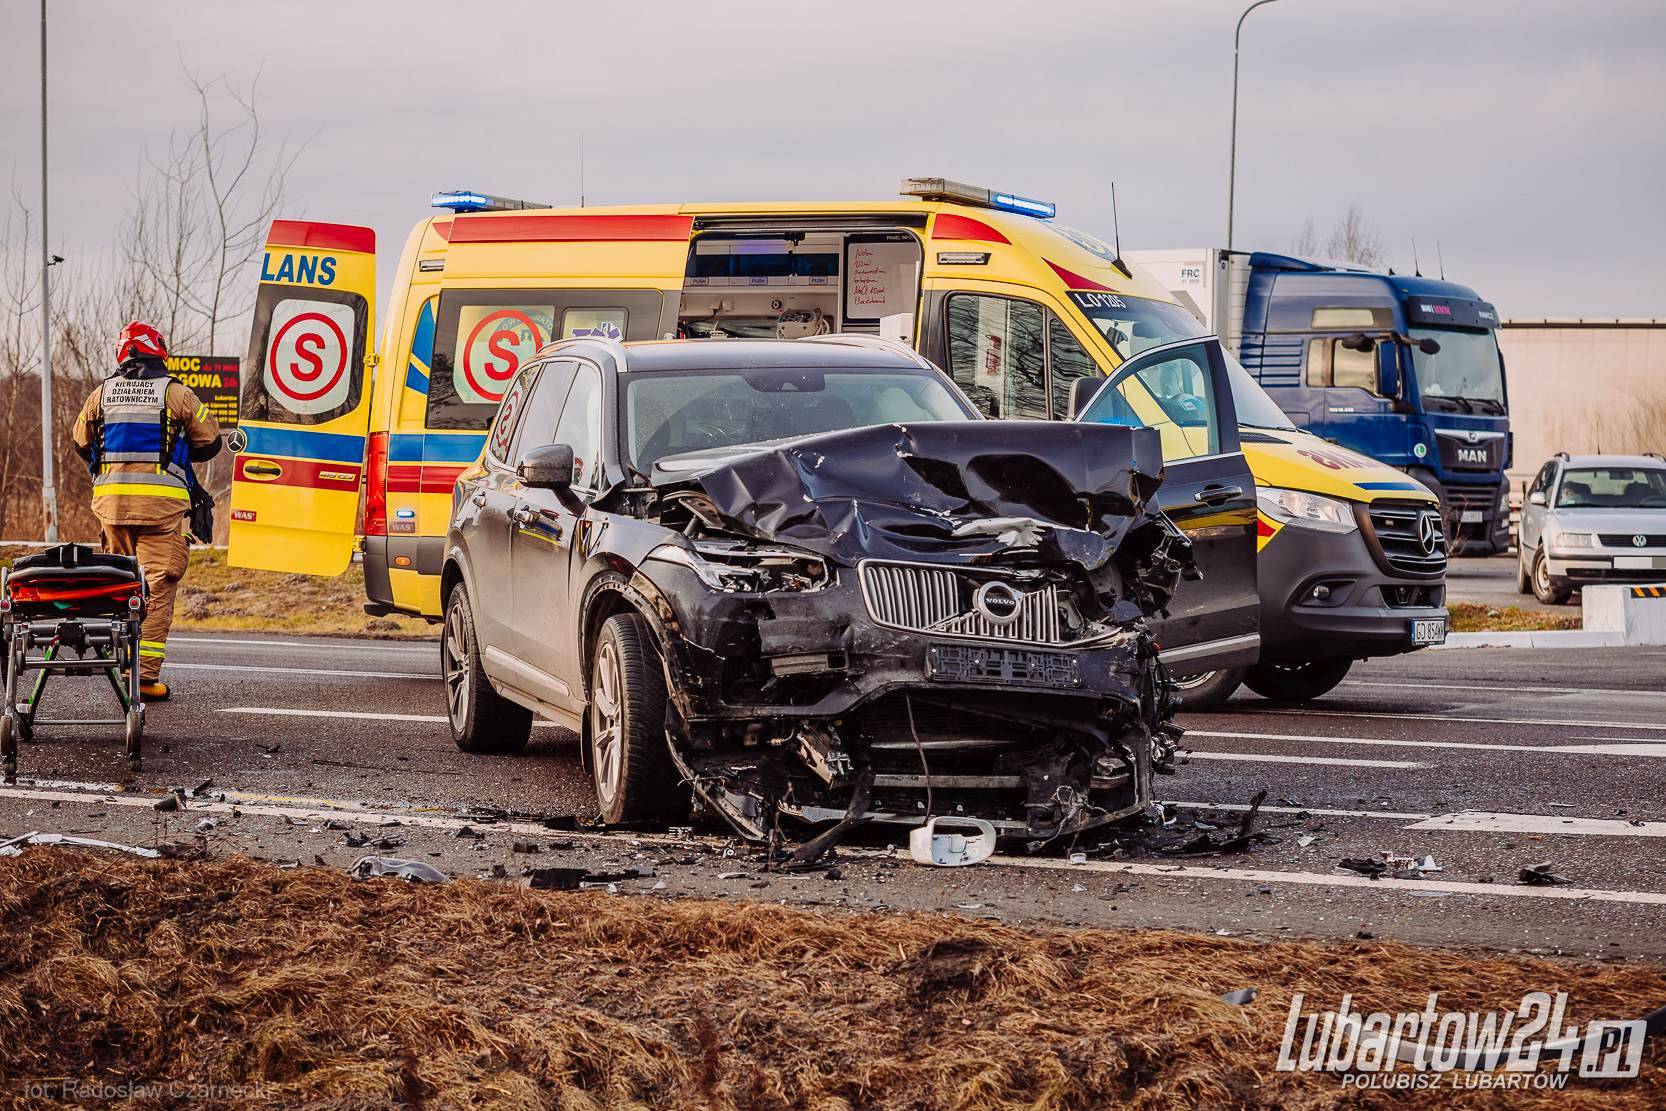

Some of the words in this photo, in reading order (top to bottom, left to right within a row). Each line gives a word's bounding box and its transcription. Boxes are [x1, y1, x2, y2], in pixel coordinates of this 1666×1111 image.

[260, 253, 337, 286] LANS
[1181, 269, 1200, 278] FRC
[290, 333, 325, 382] S
[484, 329, 520, 381] S
[163, 357, 200, 371] MOC
[166, 373, 222, 388] GOWA
[1457, 449, 1487, 463] MAN
[234, 511, 253, 520] WAS
